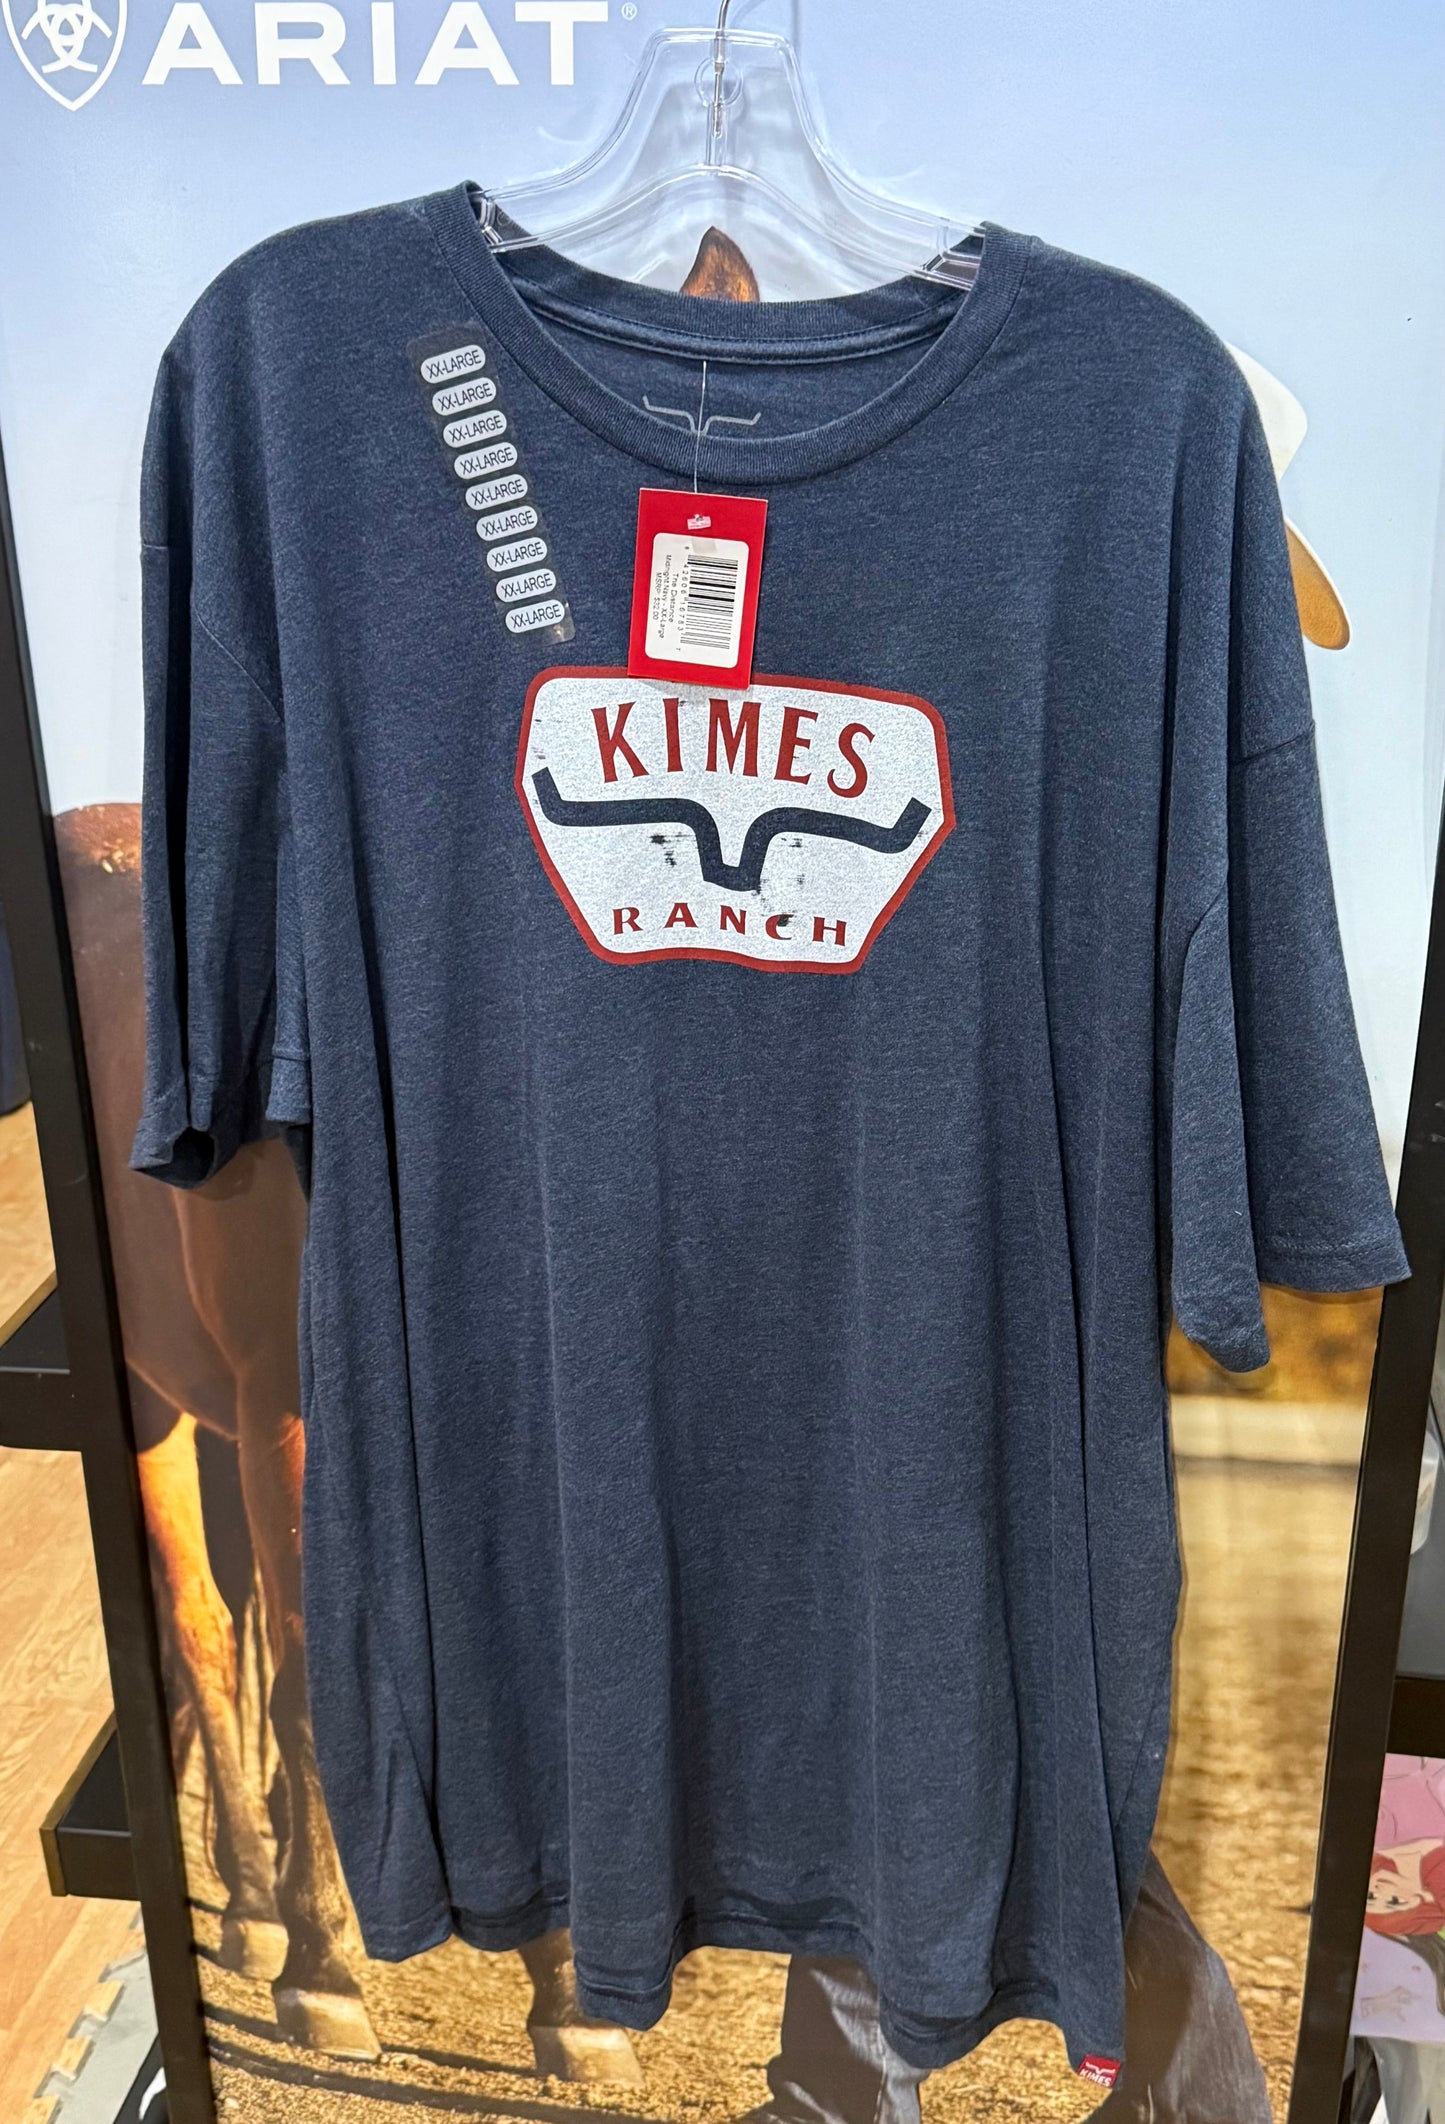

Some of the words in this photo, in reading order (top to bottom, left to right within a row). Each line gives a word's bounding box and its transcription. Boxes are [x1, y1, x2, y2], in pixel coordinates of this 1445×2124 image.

[426, 350, 482, 379] XX-LARGE
[437, 383, 494, 411] XX-LARGE
[448, 415, 503, 443] XX-LARGE
[459, 447, 514, 475] XX-LARGE
[470, 479, 525, 506] XX-LARGE
[482, 510, 534, 536] XX-LARGE
[491, 542, 544, 568] XX-LARGE
[663, 554, 672, 583] Midnight
[500, 573, 553, 599] XX-LARGE
[661, 585, 670, 601] Navy
[671, 573, 679, 587] The
[510, 605, 561, 630] XX-LARGE
[668, 589, 678, 623] Distance
[658, 607, 668, 639] XX-Large
[591, 697, 875, 798] KIMES
[612, 902, 847, 946] RANCH
[1080, 2068, 1111, 2087] KIMES
